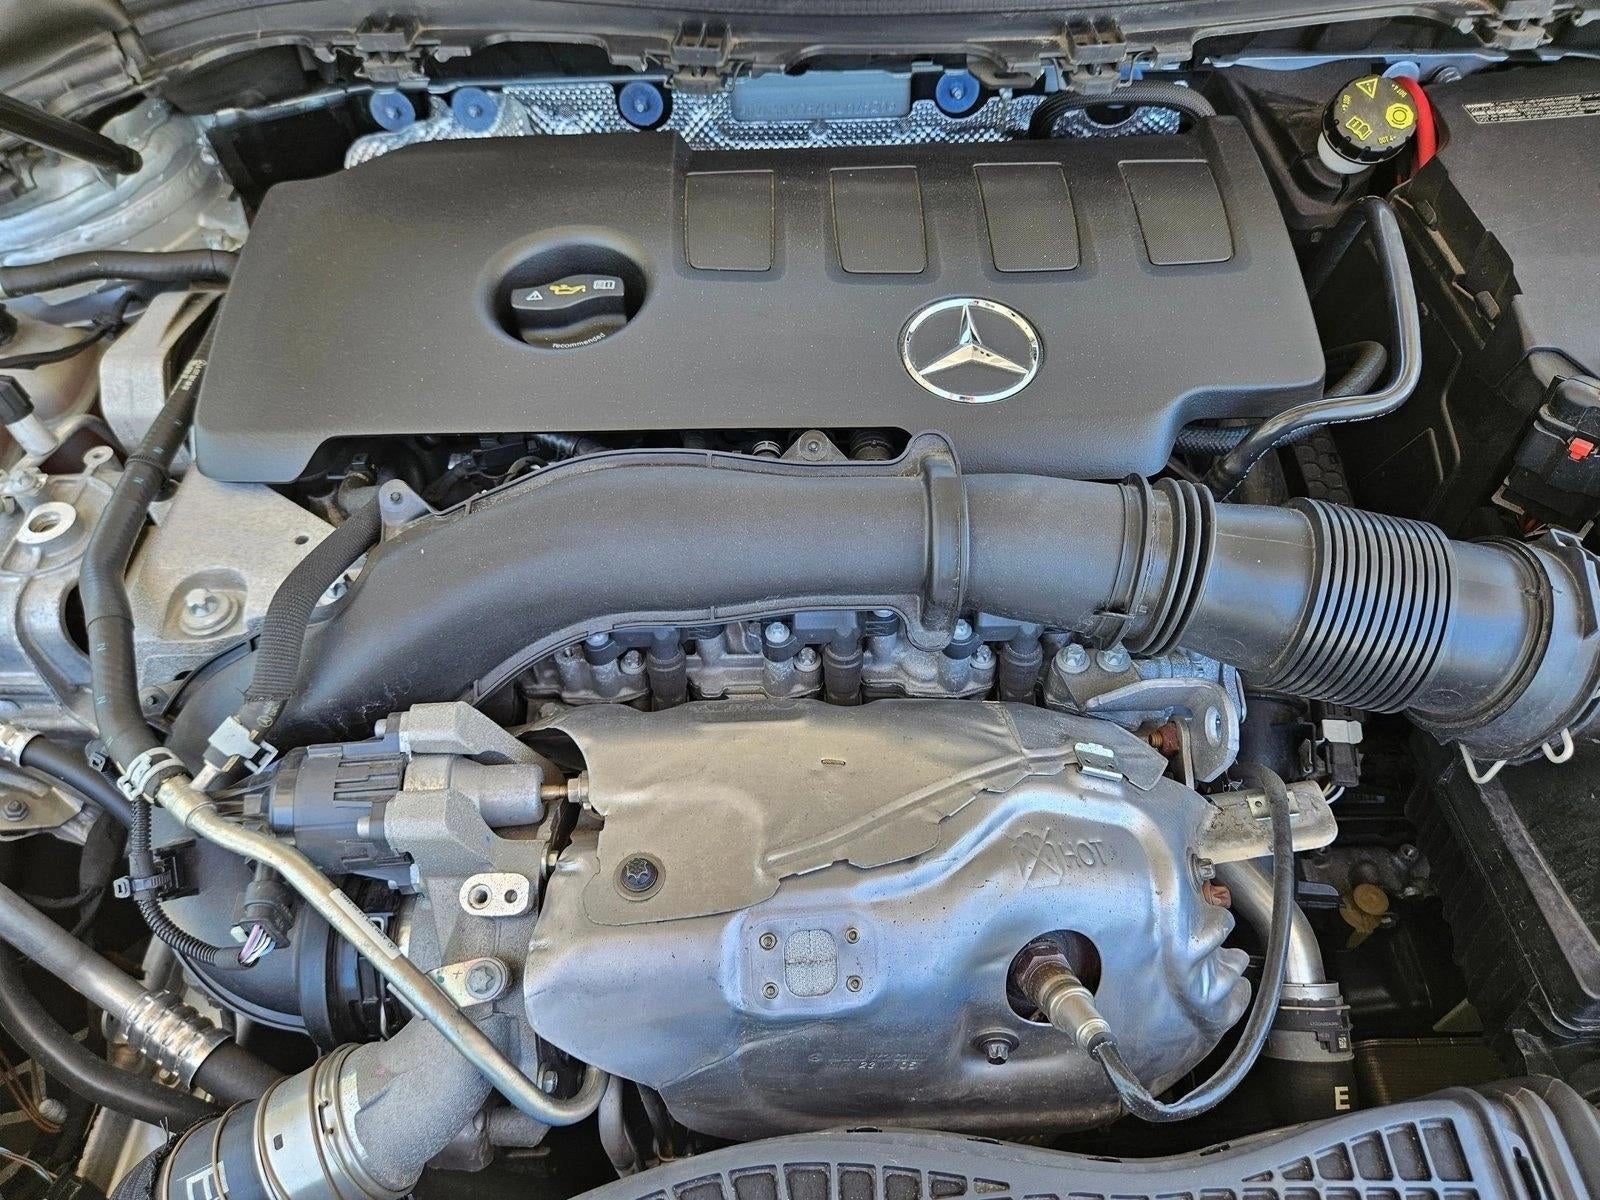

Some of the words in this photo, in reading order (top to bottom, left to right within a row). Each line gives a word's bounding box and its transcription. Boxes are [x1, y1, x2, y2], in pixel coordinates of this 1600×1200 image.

[552, 332, 606, 349] recommended
[1059, 839, 1107, 868] HOT
[1334, 1086, 1350, 1110] E
